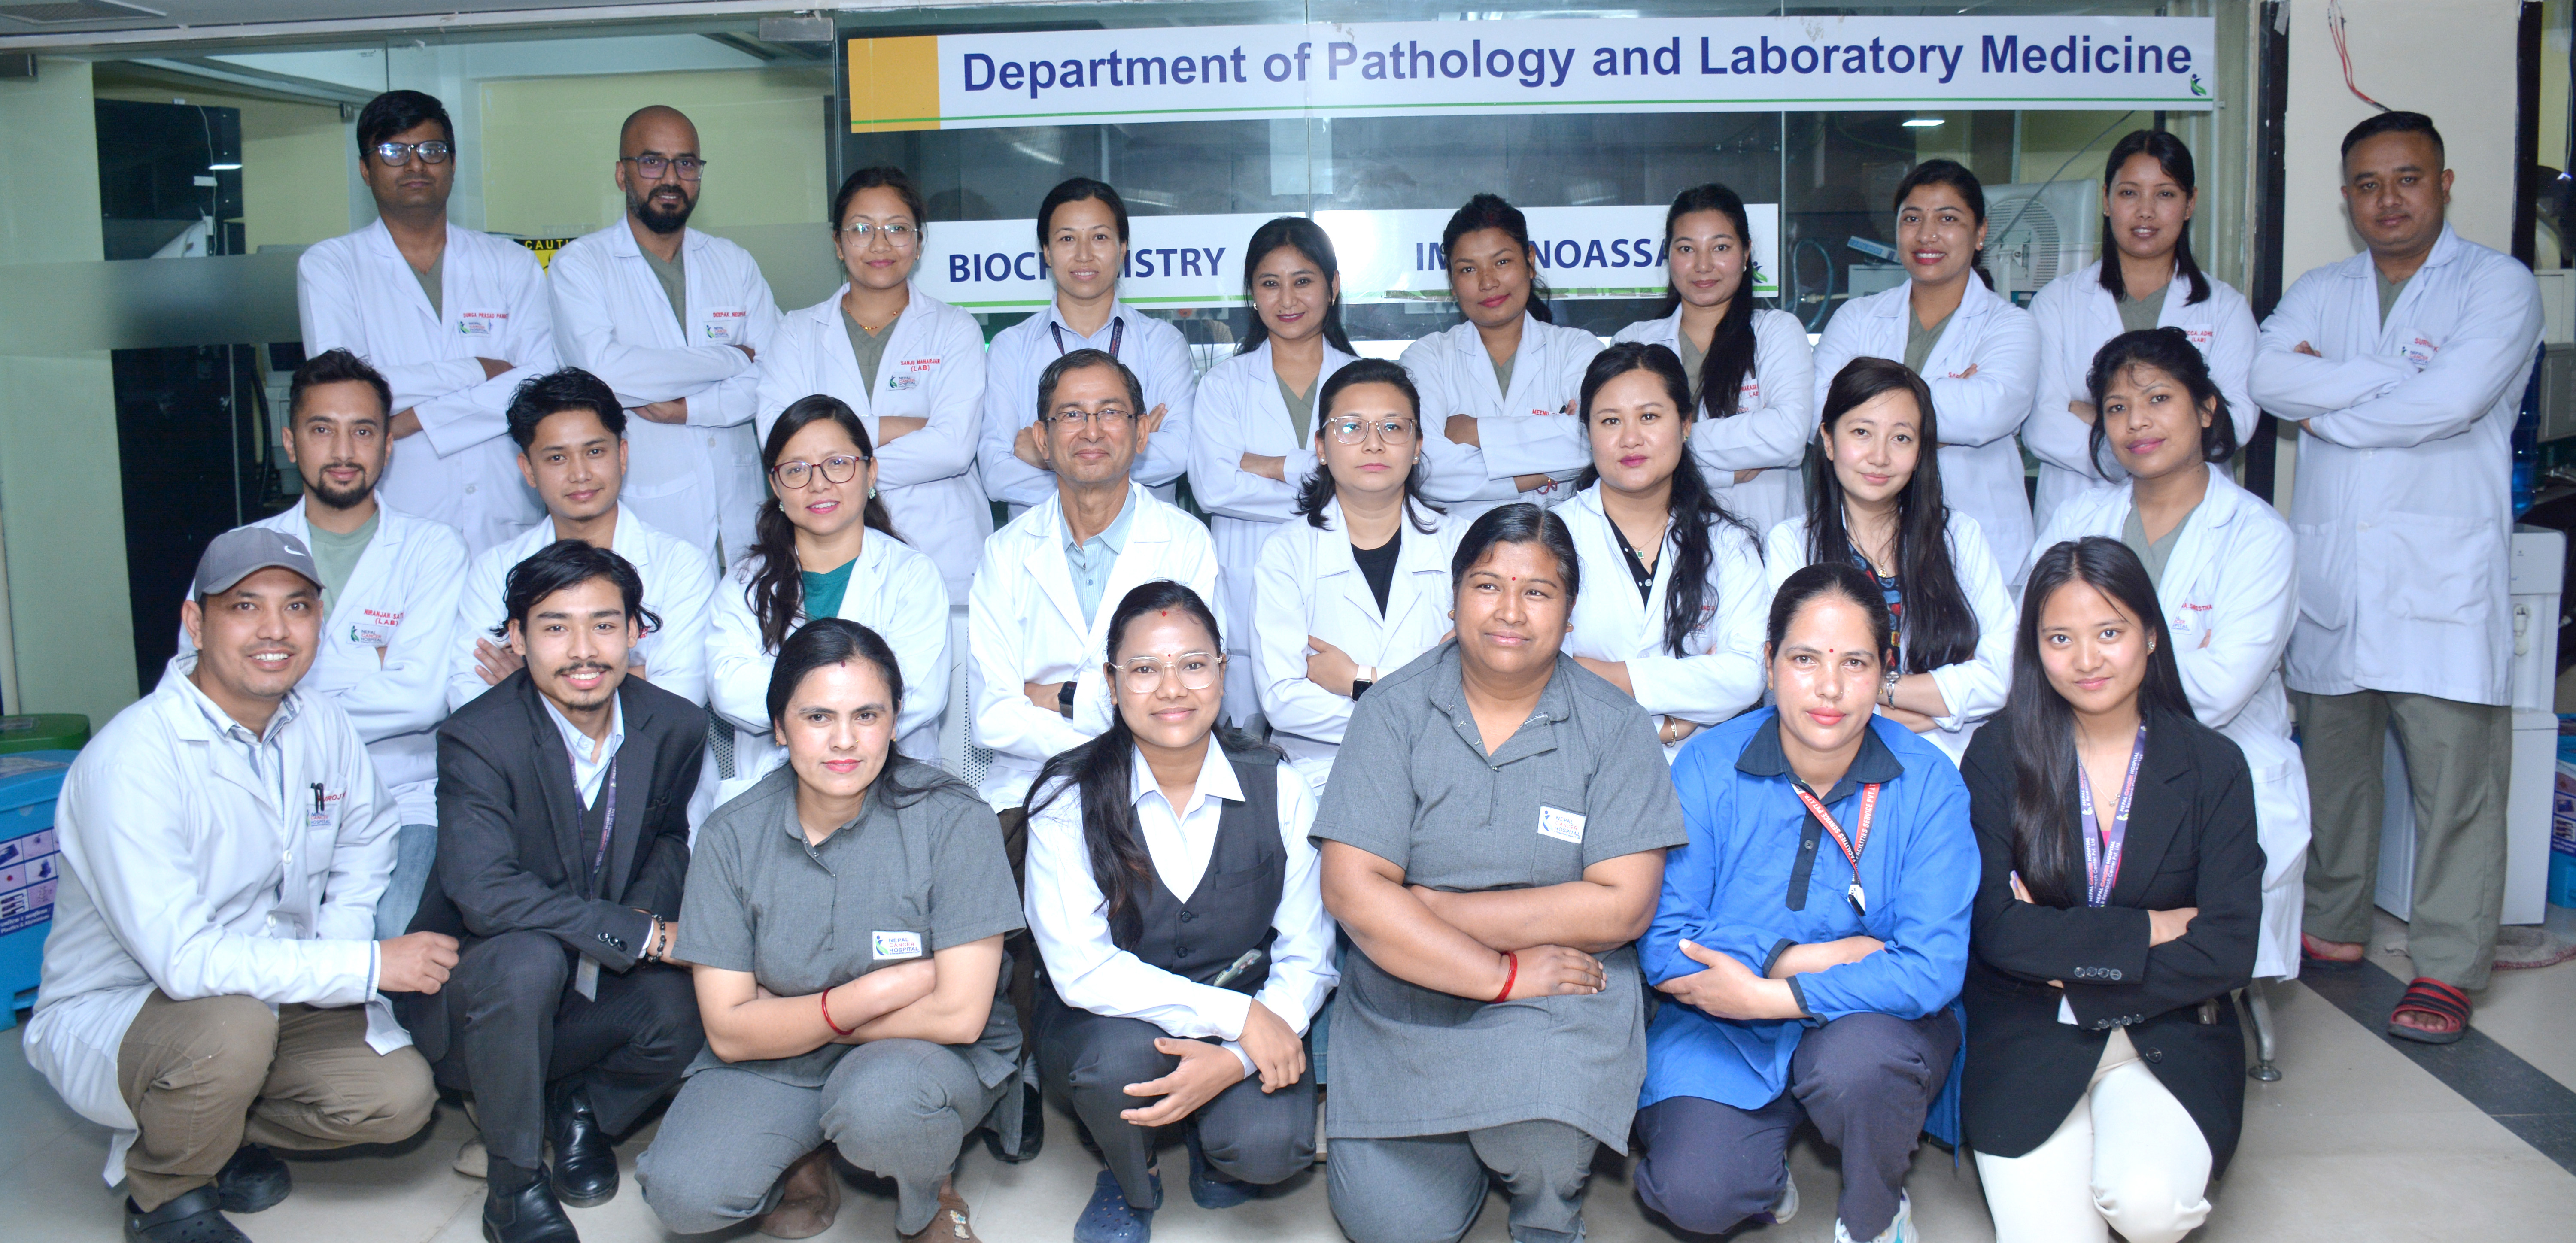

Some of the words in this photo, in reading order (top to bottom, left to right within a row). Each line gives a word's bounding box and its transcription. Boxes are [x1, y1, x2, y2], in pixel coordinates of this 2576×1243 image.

[964, 46, 1247, 99] Department
[1264, 42, 1312, 82] of
[1328, 39, 1575, 87] Pathology
[1593, 36, 1680, 76] and
[1701, 36, 1964, 84] Laboratory
[1982, 35, 2192, 74] Medicine
[364, 609, 391, 618] NIRANJAN
[375, 618, 398, 627] (LAB)
[2119, 797, 2128, 812] NEPAL
[2129, 752, 2139, 774] HOSPITAL
[1555, 821, 1578, 831] CANCER
[1556, 816, 1574, 825] NEPAL
[1821, 812, 1841, 834] SERVICE
[1863, 803, 1872, 827] SERVICE
[1554, 826, 1580, 837] HOSPITAL
[1838, 833, 1856, 863] FACILITIES
[2095, 888, 2104, 904] NEPAL
[2105, 840, 2116, 864] HOSPITAL
[2101, 878, 2111, 900] Research
